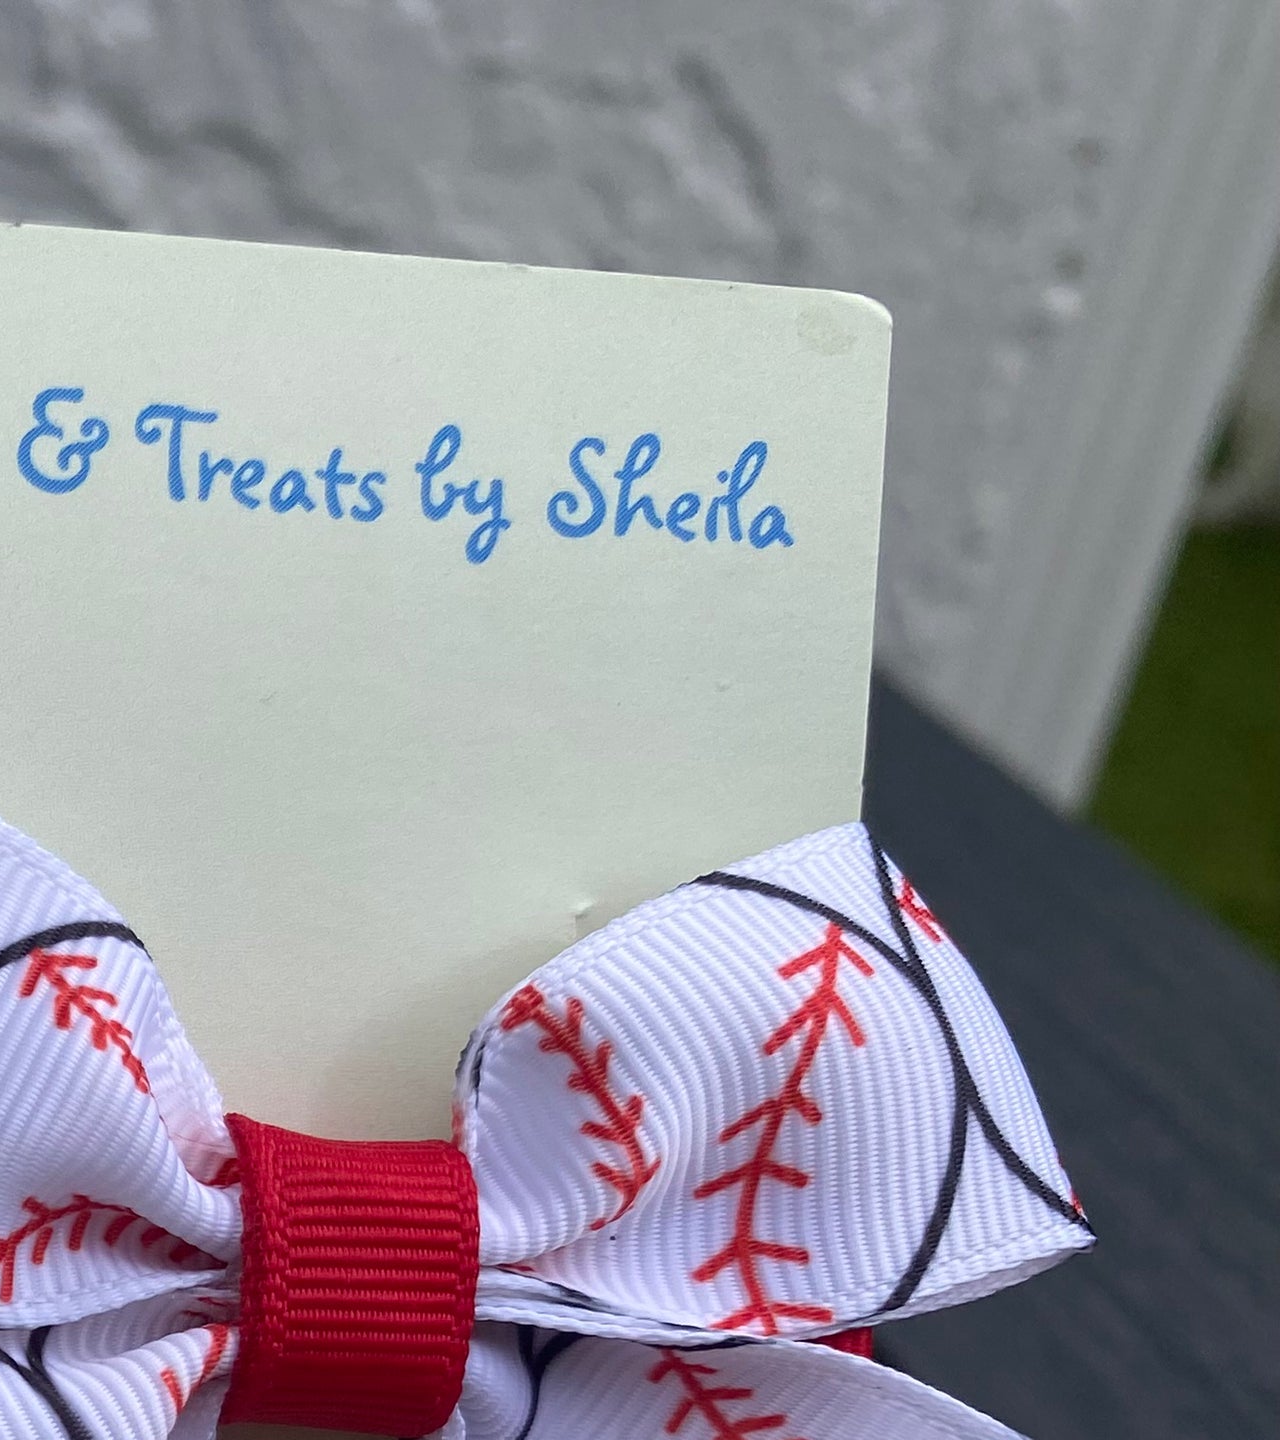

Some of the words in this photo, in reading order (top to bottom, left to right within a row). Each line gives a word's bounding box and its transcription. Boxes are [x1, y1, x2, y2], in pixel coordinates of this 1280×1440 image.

[14, 384, 113, 496] &
[132, 401, 389, 525] Treats
[413, 422, 514, 567] by
[545, 430, 797, 552] Sheila
